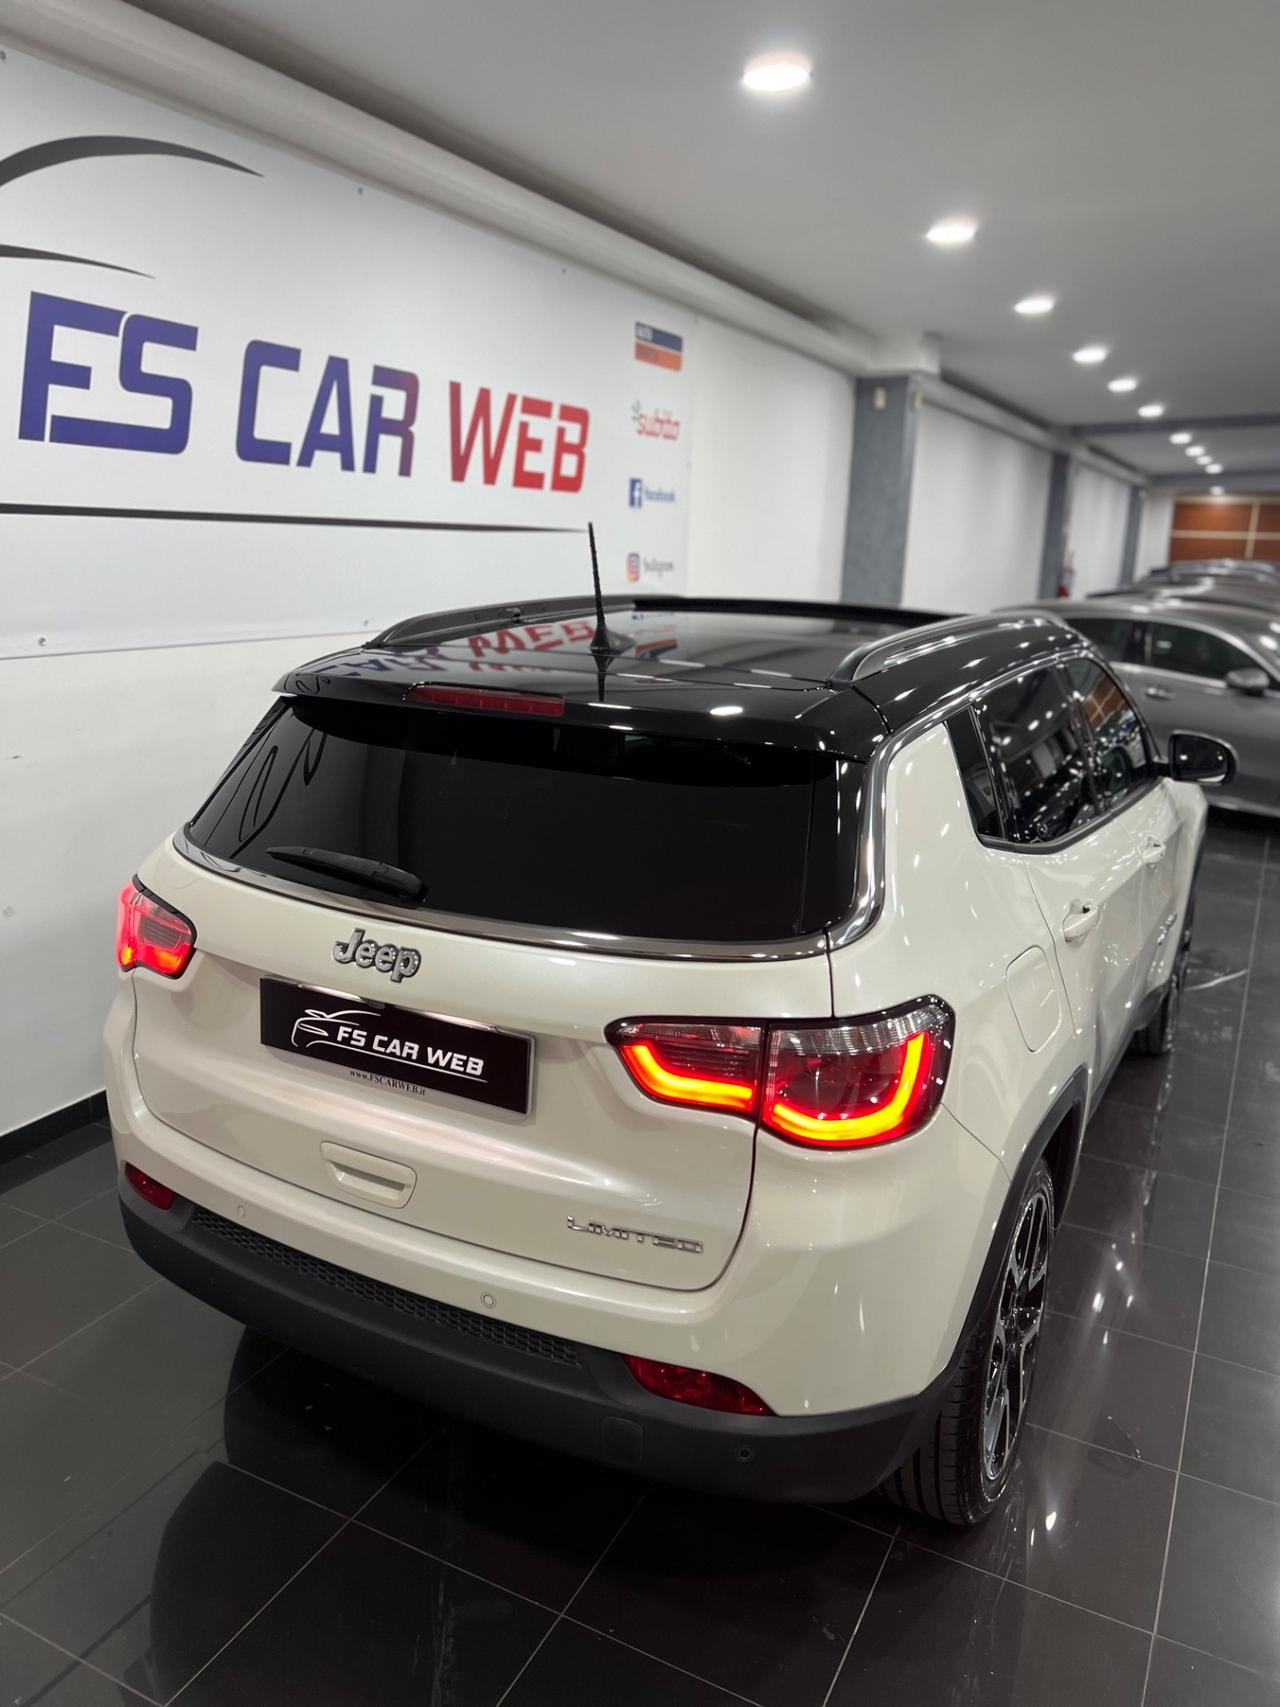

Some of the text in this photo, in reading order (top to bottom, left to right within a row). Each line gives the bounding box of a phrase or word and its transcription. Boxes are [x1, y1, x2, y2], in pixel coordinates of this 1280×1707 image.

[18, 291, 590, 493] FS CAR WEB
[333, 928, 421, 982] Jeep
[337, 1026, 484, 1076] FS CAR WEB
[350, 1070, 426, 1096] www.FSCARWEB.it
[567, 1215, 703, 1253] LIMITED
